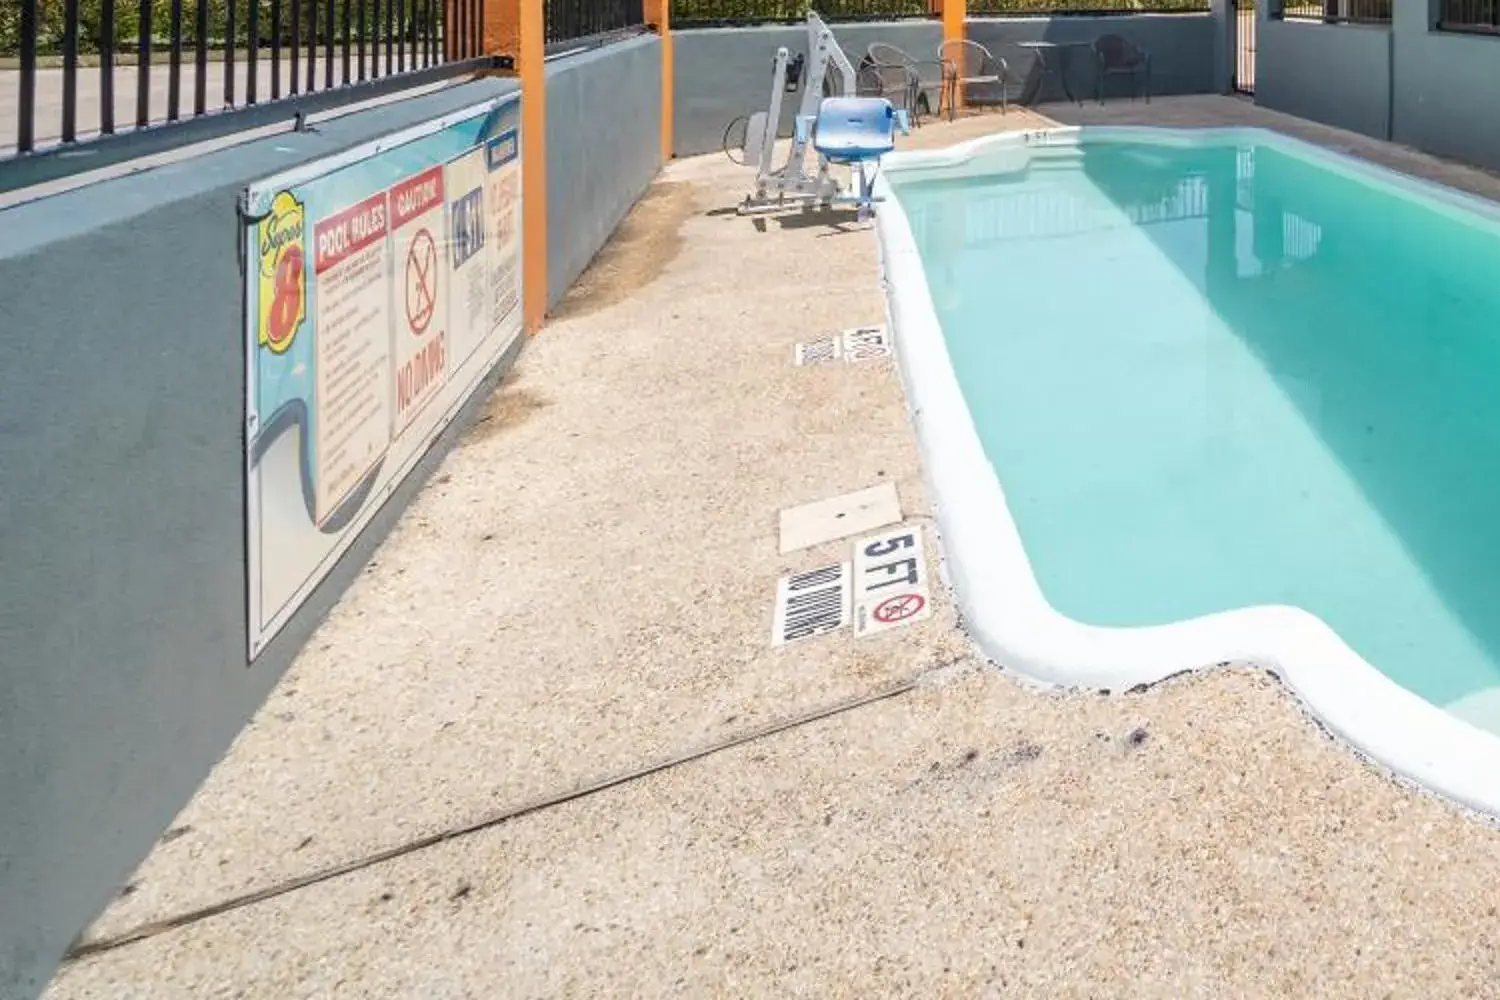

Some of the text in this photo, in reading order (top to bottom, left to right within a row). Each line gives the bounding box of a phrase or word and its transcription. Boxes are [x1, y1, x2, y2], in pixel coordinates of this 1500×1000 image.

[320, 203, 385, 263] POOL RULES
[268, 245, 303, 343] 8
[865, 534, 918, 591] 5 FT
